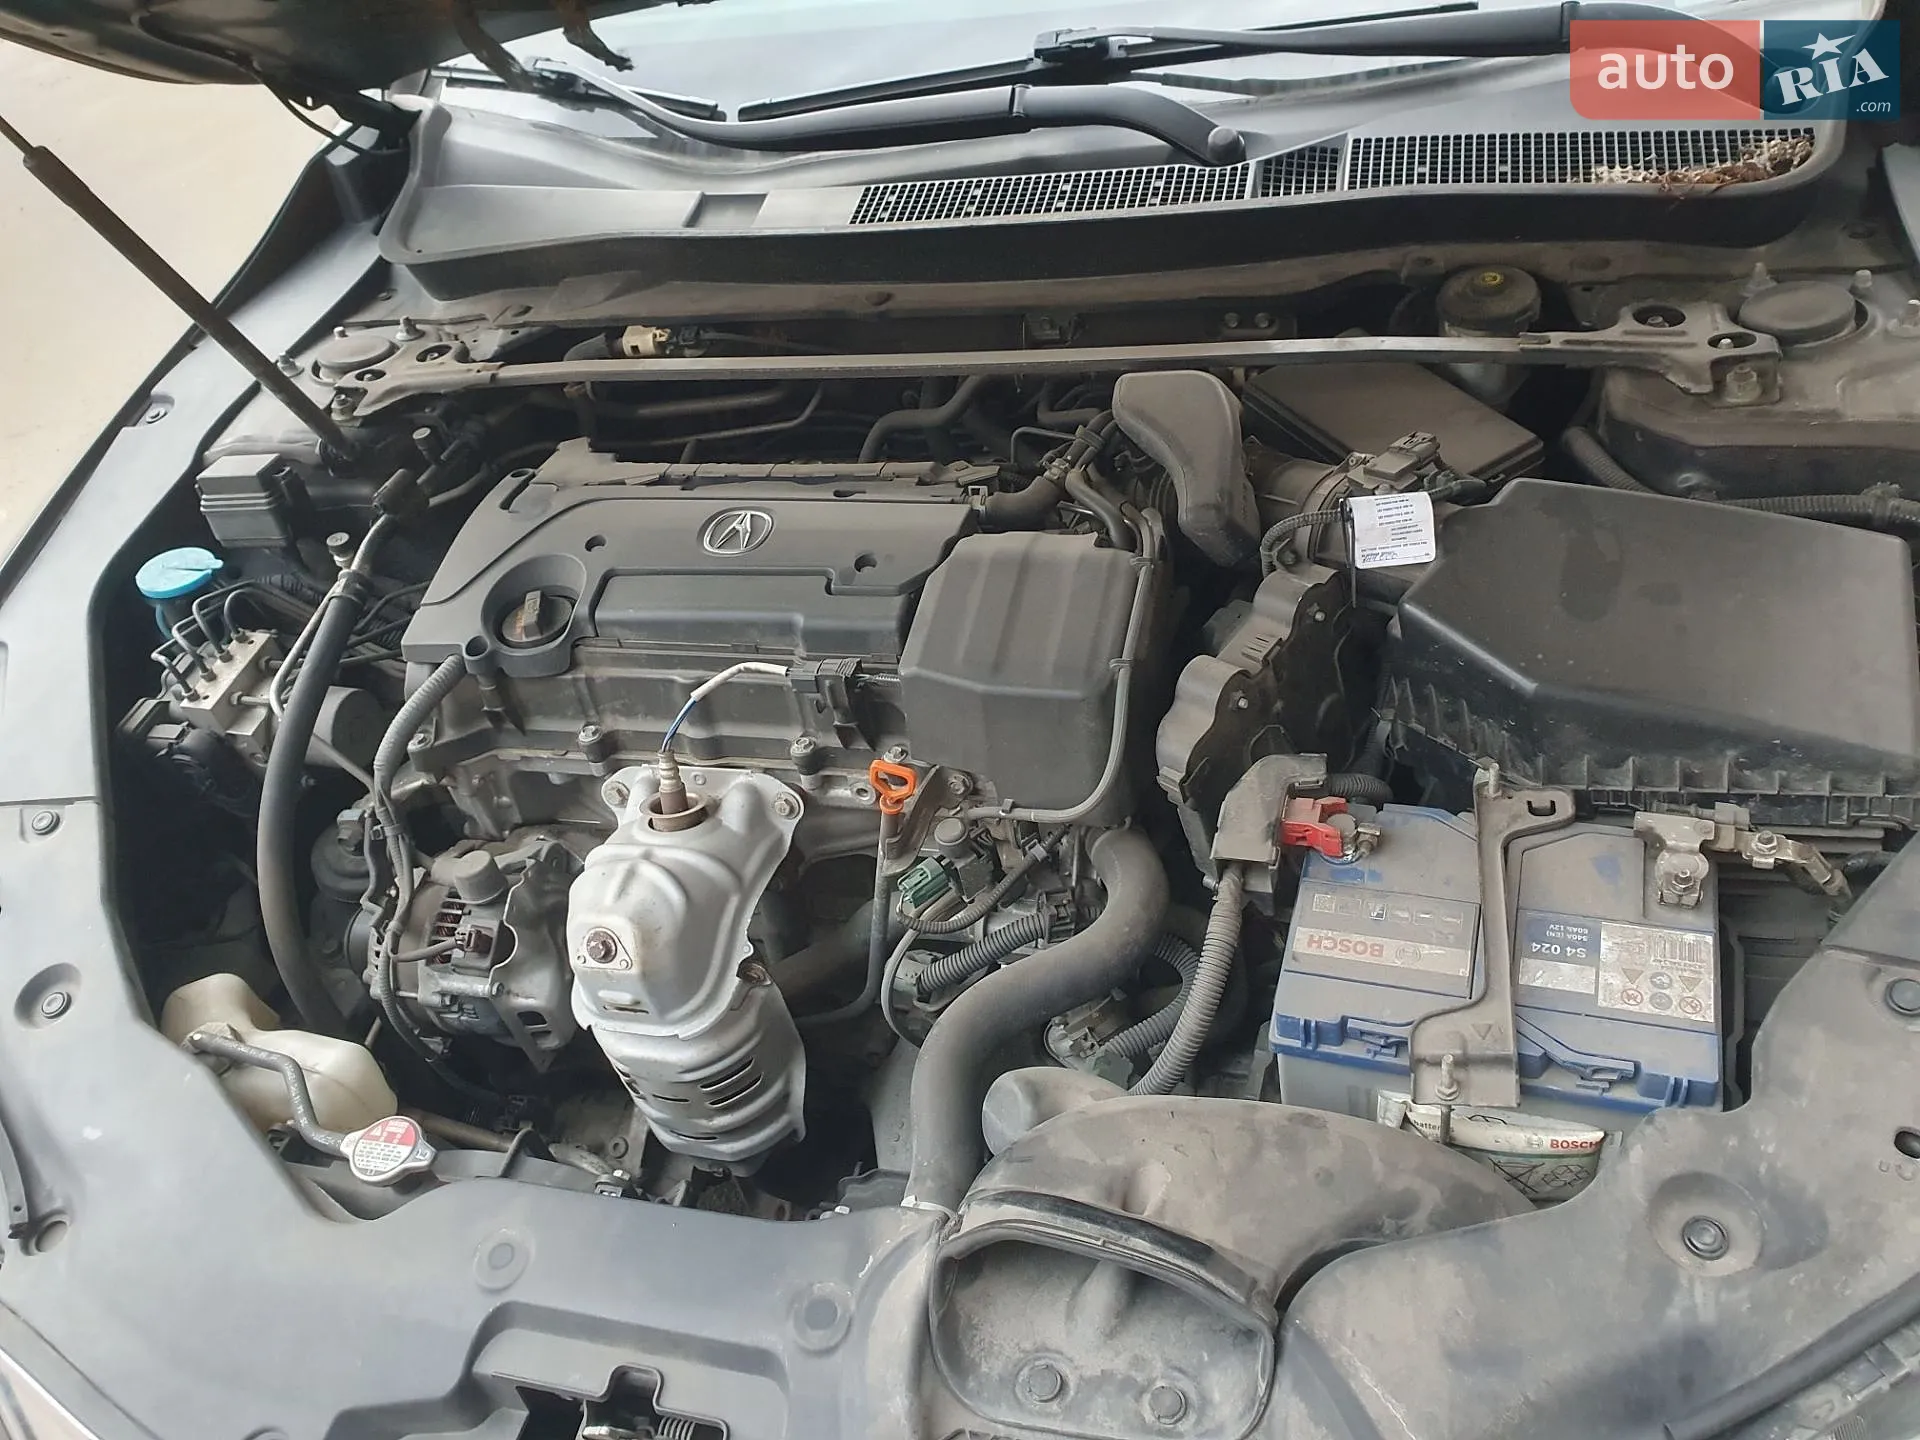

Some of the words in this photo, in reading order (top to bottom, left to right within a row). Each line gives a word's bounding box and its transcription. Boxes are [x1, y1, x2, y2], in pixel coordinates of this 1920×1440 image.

[1306, 934, 1385, 958] BOSCH
[1531, 941, 1561, 955] 024
[1565, 946, 1587, 958] S4
[1550, 1139, 1600, 1150] BOSCH
